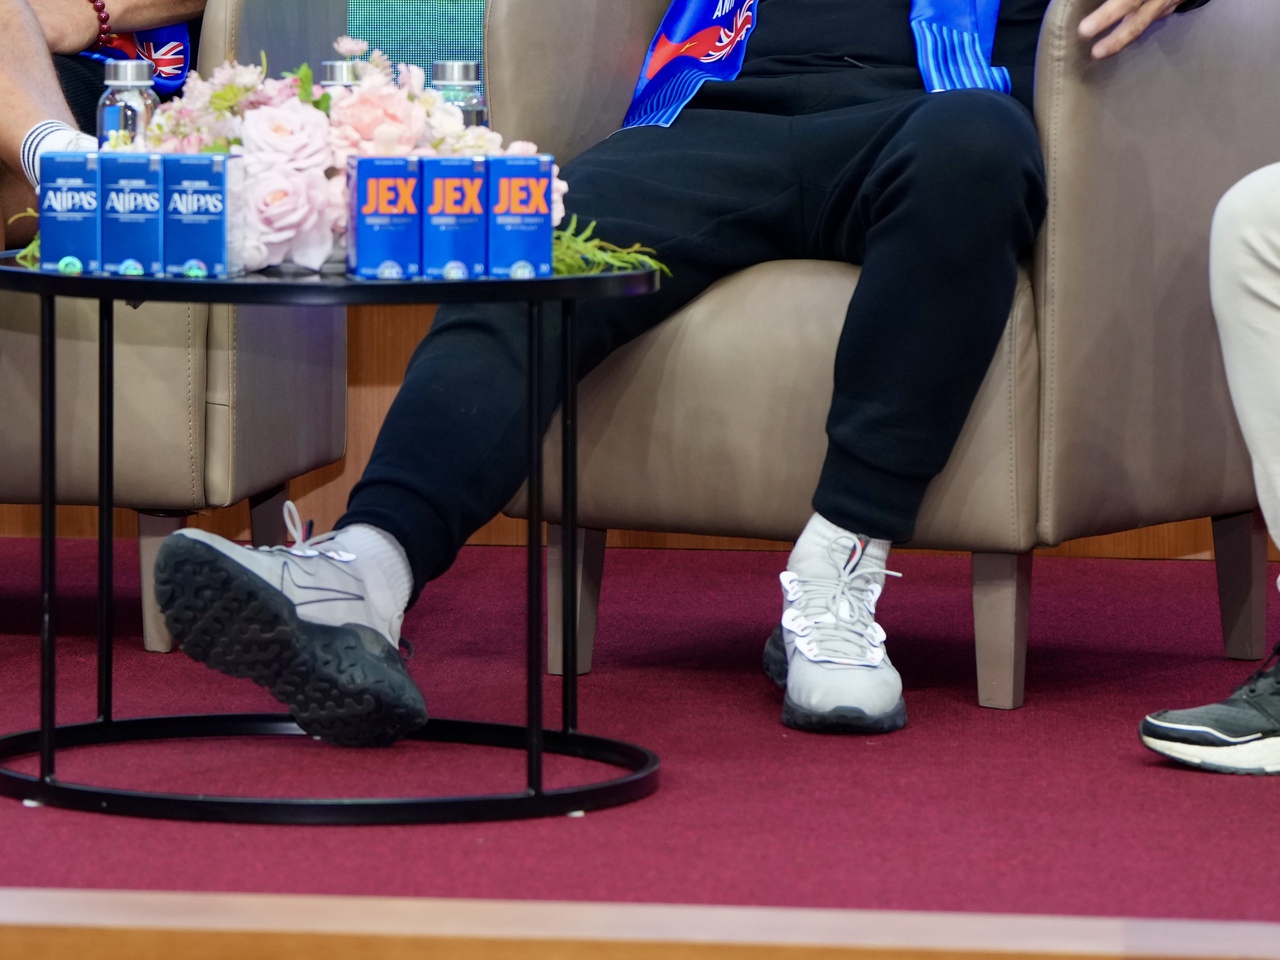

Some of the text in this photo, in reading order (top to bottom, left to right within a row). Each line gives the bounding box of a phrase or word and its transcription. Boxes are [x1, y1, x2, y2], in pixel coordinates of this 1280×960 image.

[361, 177, 418, 215] JEX
[427, 177, 484, 215] JEX
[492, 177, 550, 215] JEX
